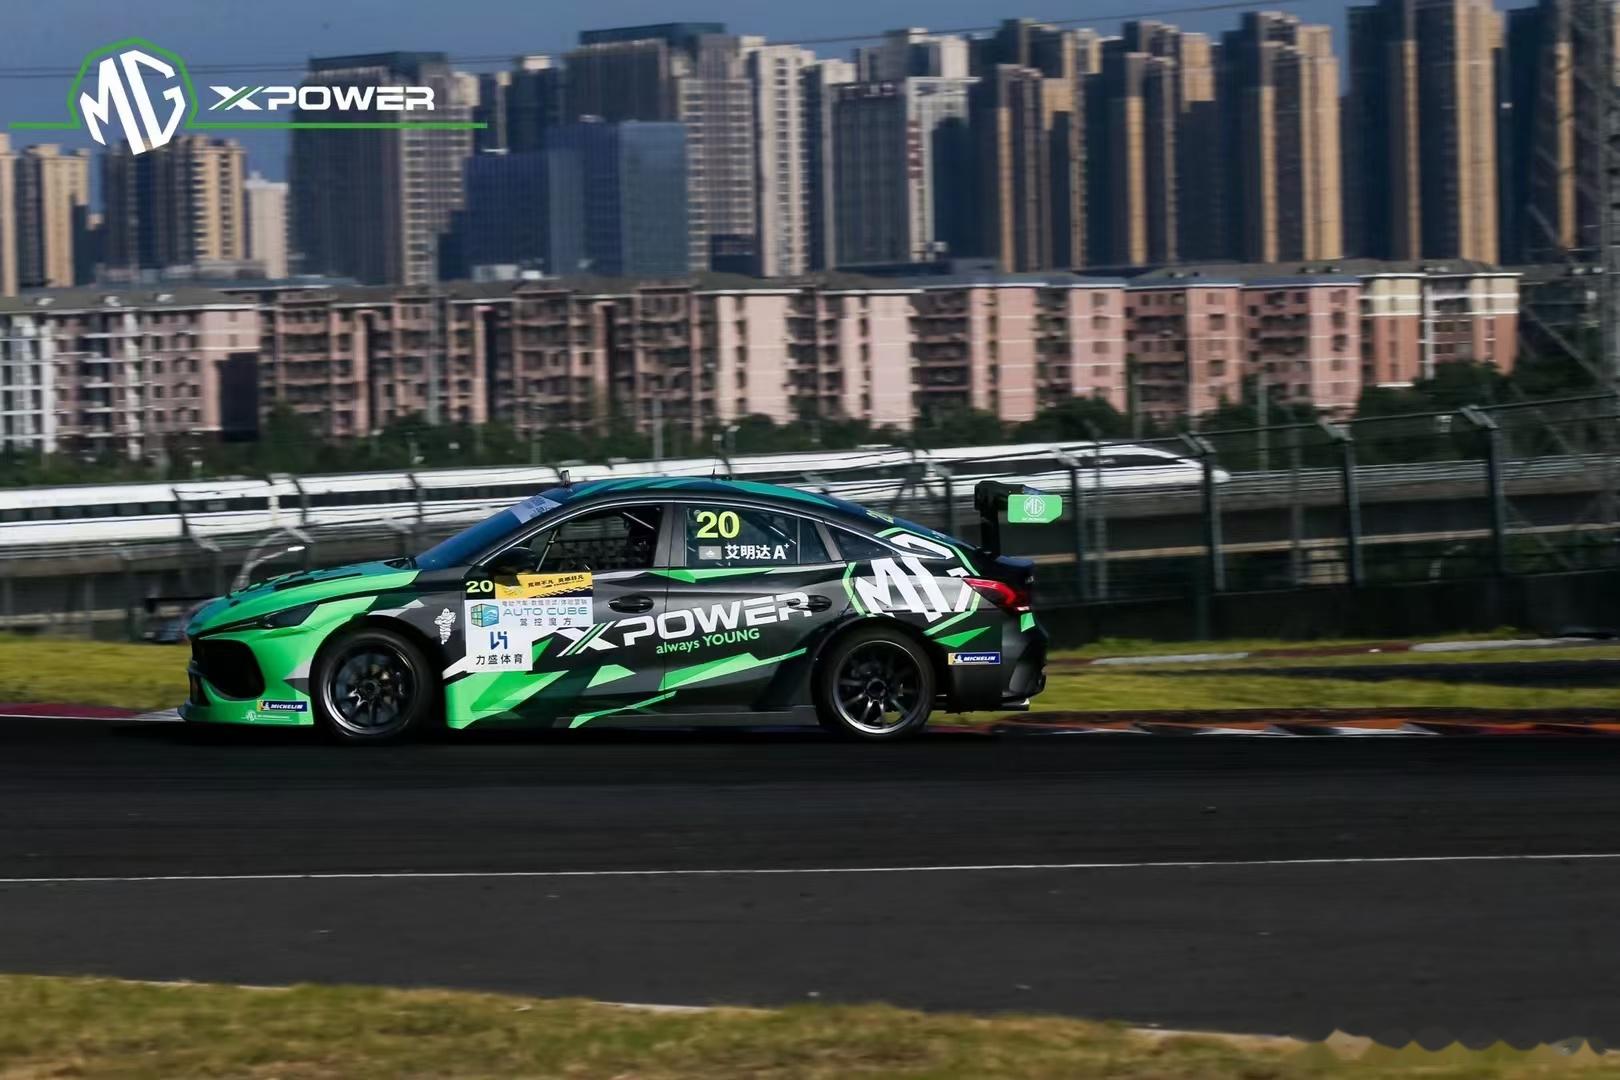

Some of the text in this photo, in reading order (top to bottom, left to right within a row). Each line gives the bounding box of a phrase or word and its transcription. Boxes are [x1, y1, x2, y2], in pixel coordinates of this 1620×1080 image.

[696, 511, 740, 539] 20
[465, 580, 494, 594] 20
[503, 606, 588, 617] AUTO CUBE
[556, 591, 814, 658] XPOWER
[656, 628, 760, 655] always YOUNG
[476, 653, 523, 665] 力盛体育
